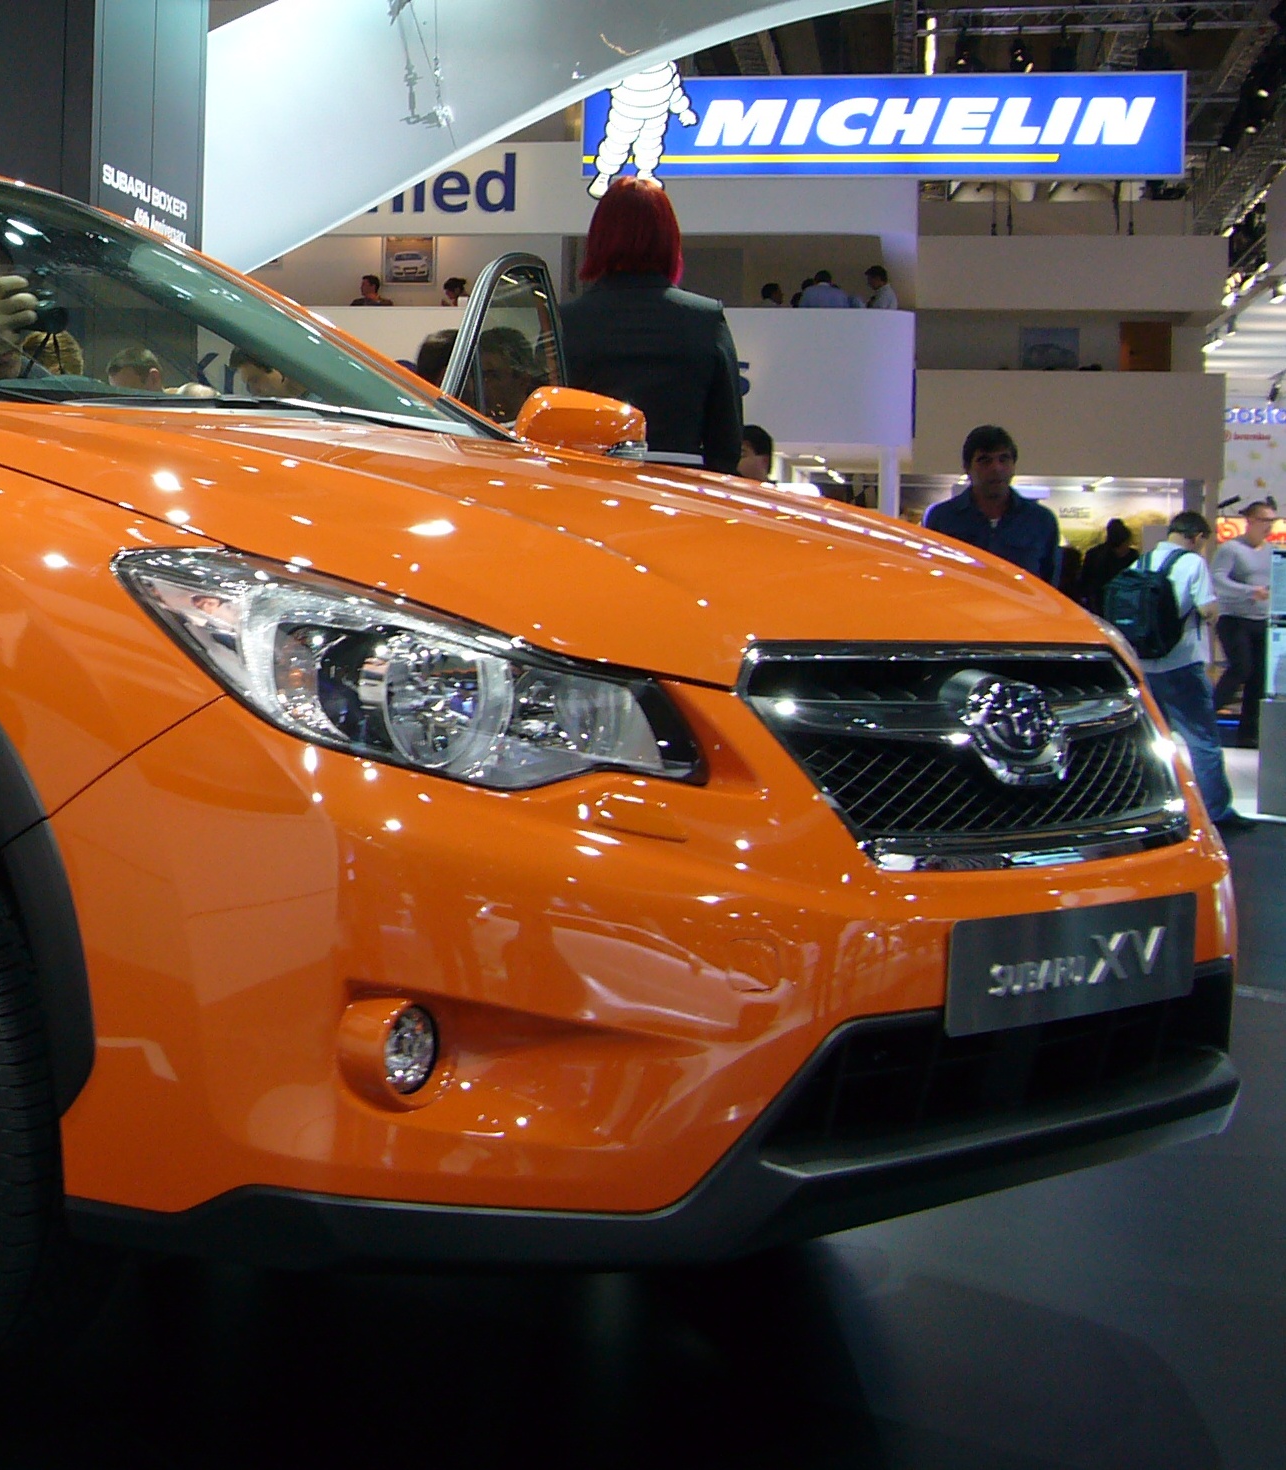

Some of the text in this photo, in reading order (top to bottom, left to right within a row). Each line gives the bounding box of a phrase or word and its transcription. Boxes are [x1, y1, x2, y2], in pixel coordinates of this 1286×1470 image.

[695, 97, 1156, 147] MICHELIN
[102, 163, 188, 220] SUBARU BOXER
[988, 926, 1166, 996] SUBARU XV
